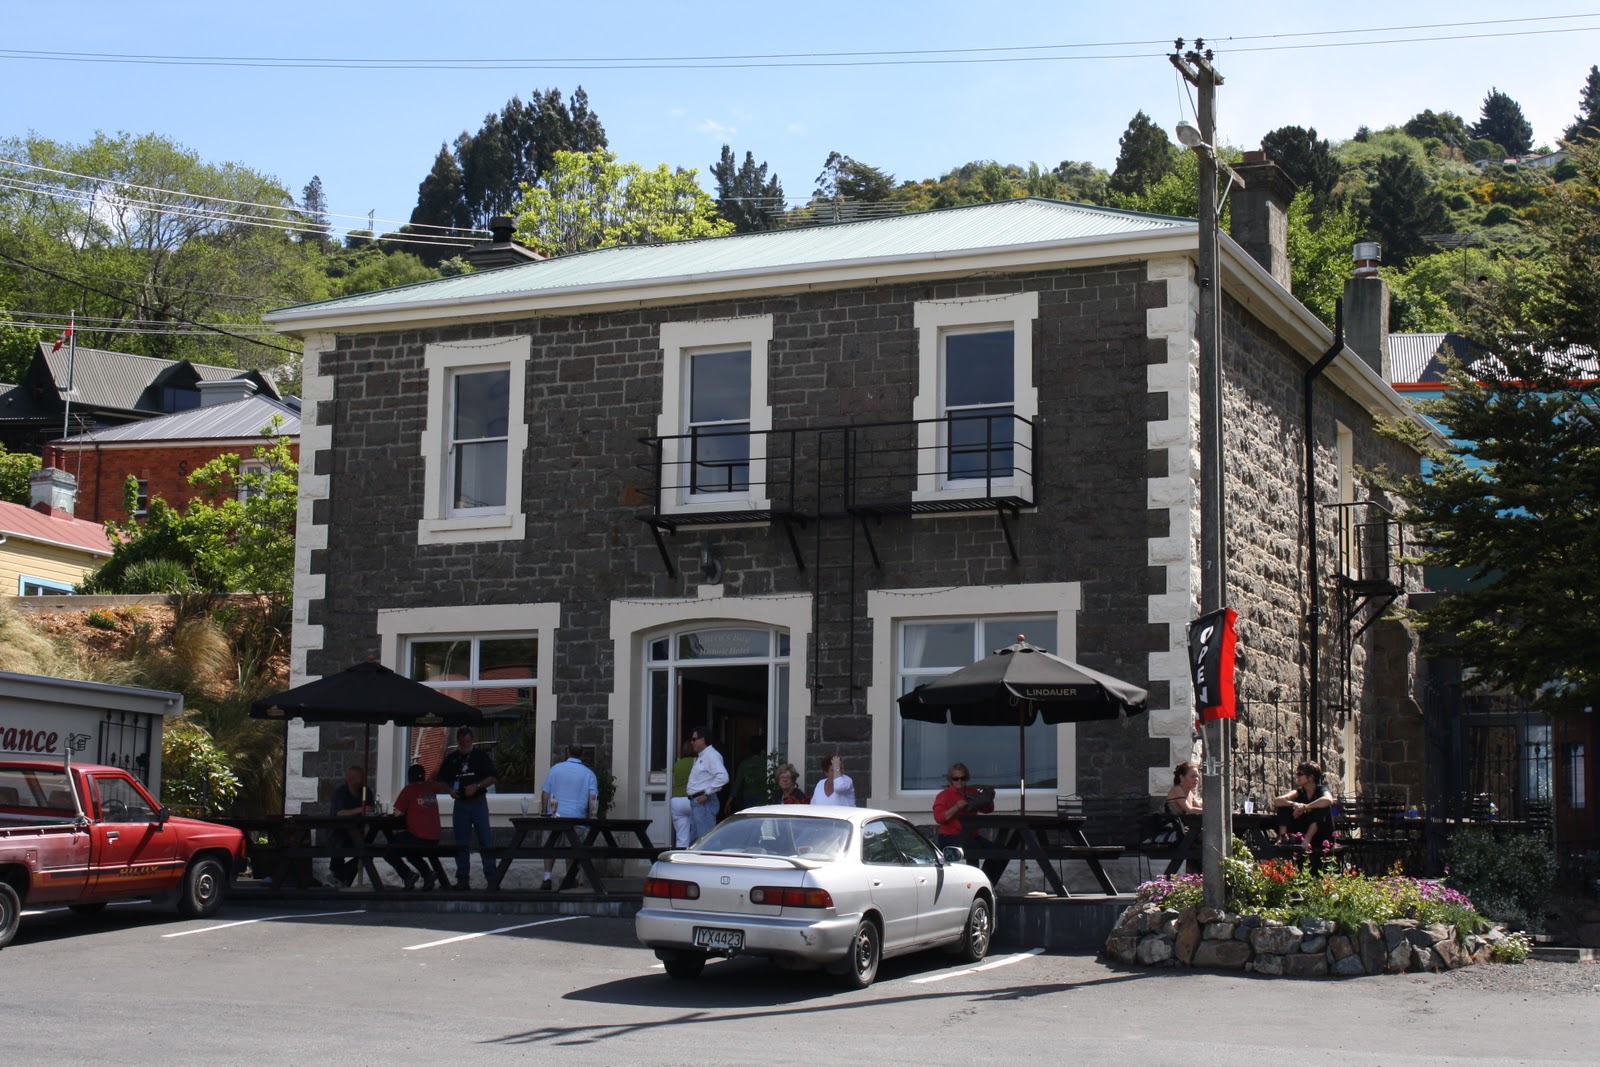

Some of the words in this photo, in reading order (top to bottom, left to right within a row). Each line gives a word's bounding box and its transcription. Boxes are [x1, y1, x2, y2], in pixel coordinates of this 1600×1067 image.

[1206, 560, 1212, 570] 7
[1026, 688, 1077, 696] LINDAUER
[700, 930, 741, 946] YX4423
